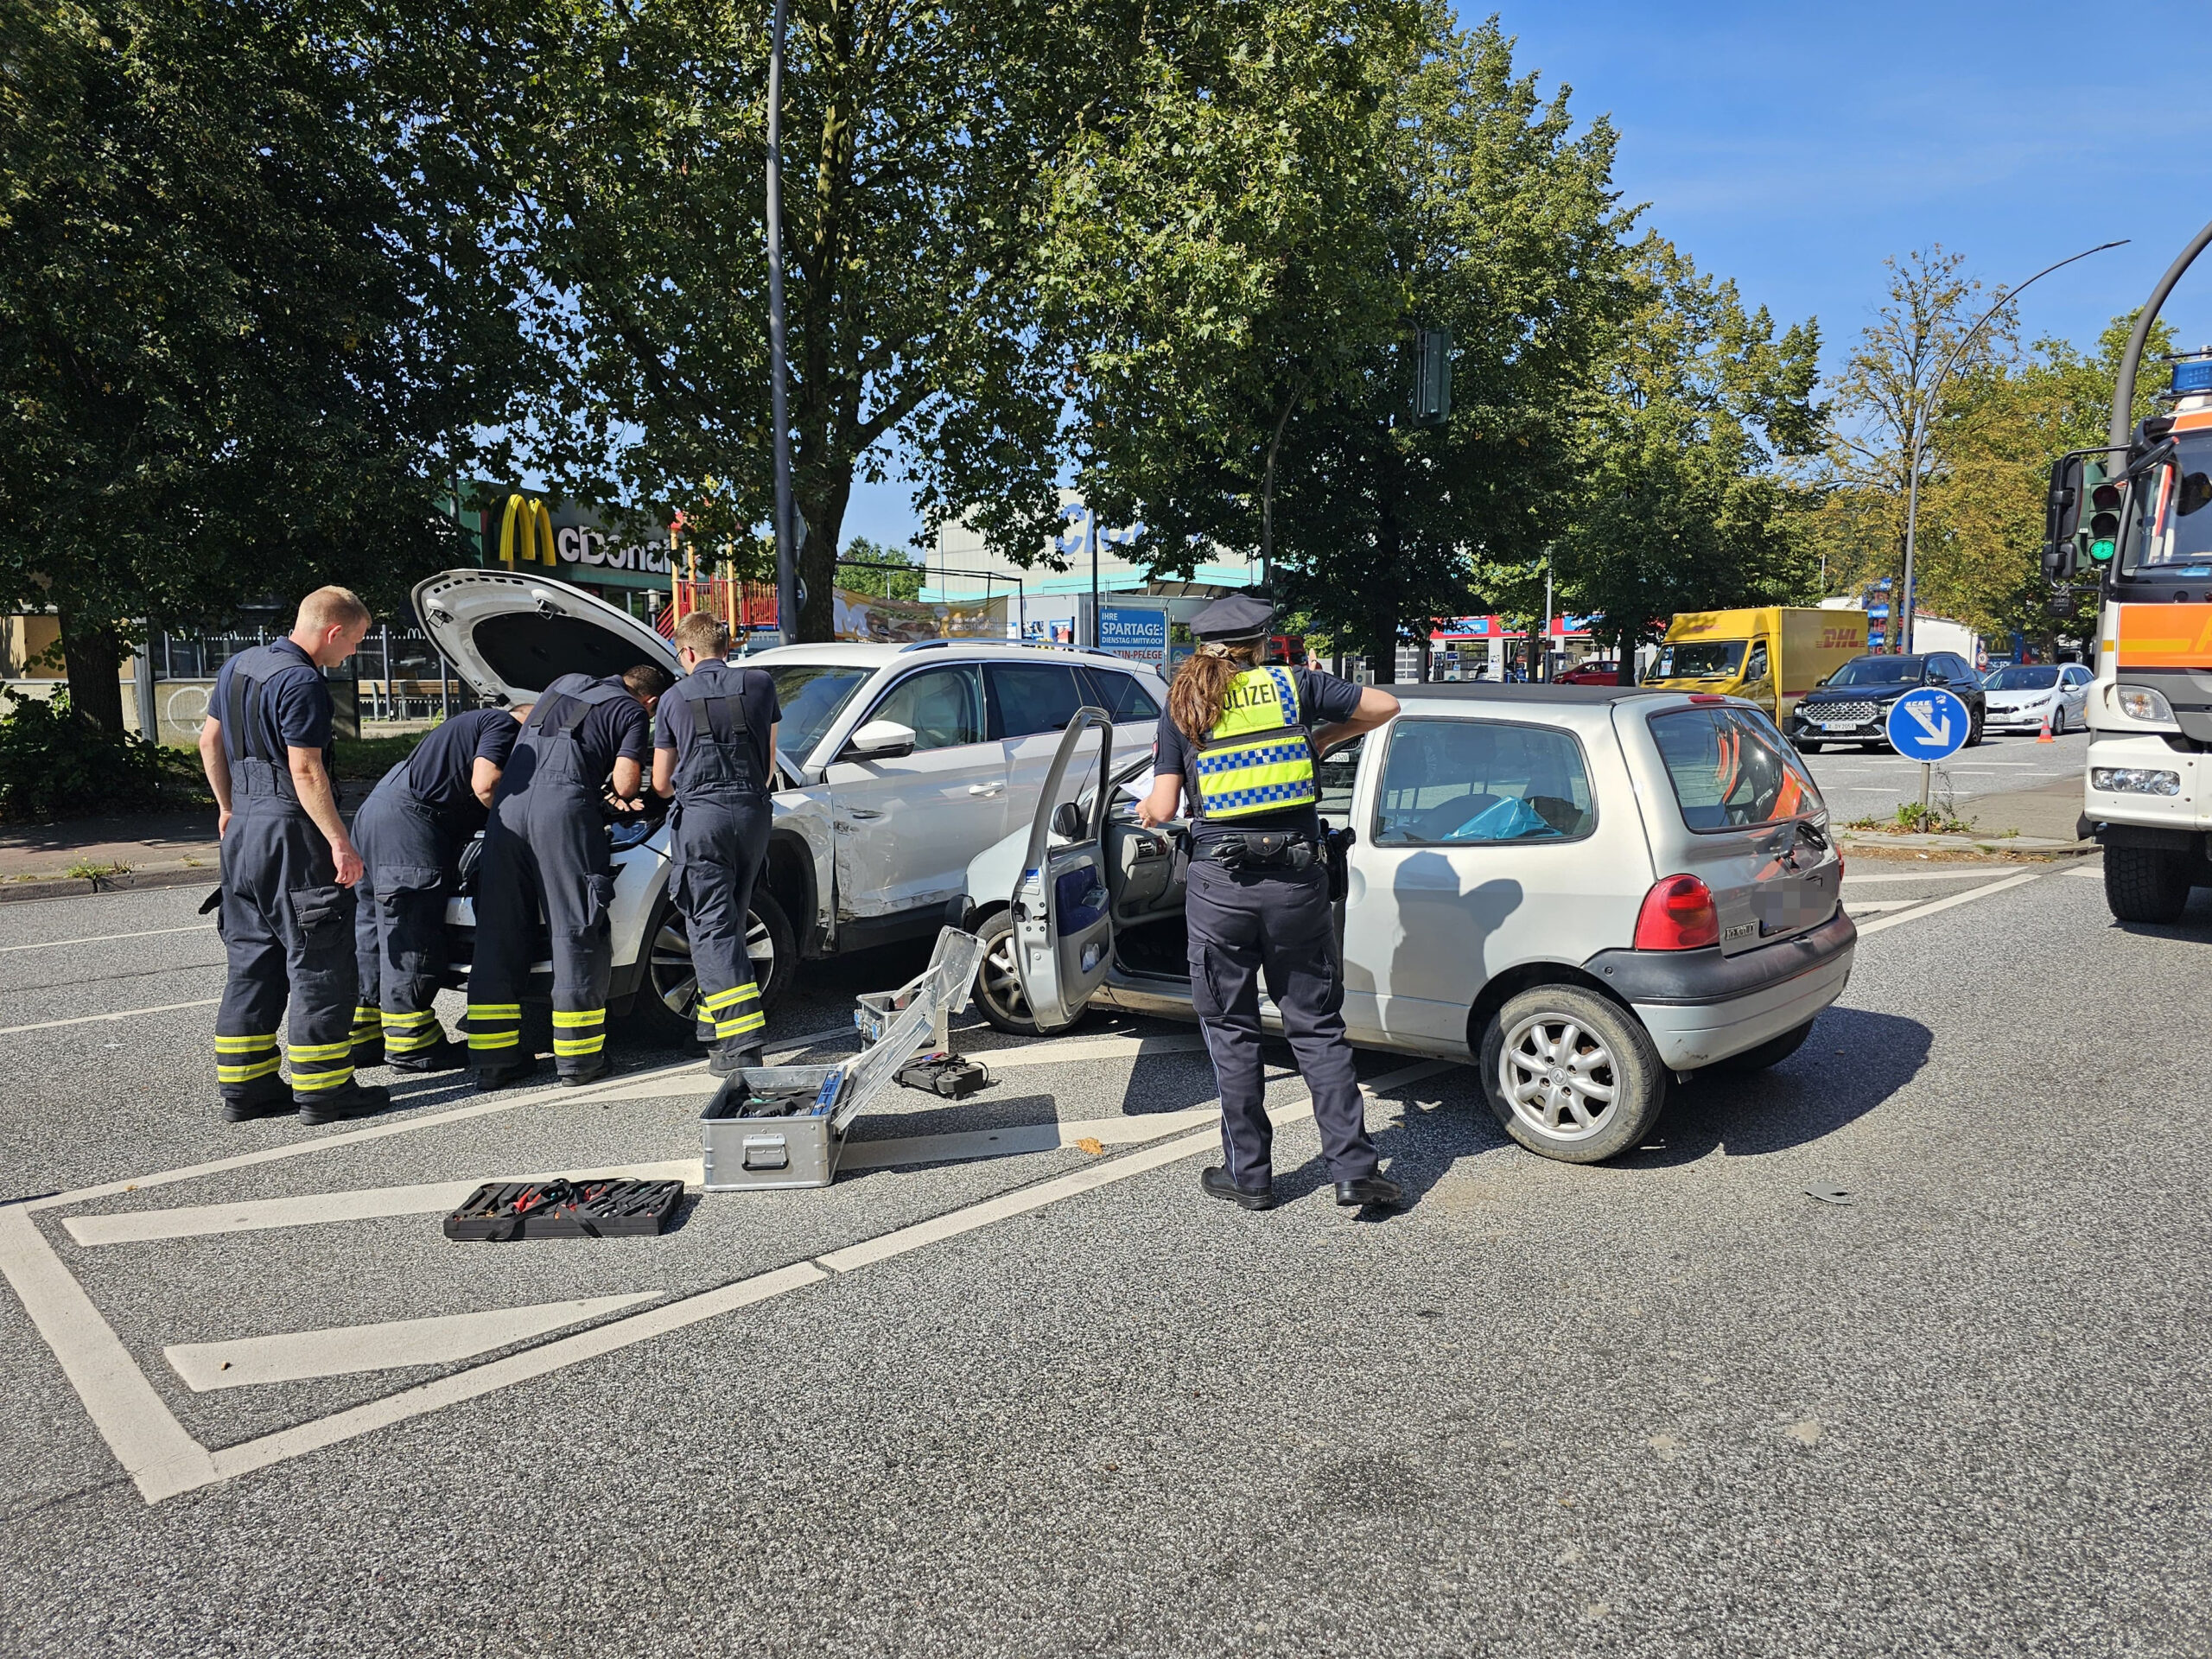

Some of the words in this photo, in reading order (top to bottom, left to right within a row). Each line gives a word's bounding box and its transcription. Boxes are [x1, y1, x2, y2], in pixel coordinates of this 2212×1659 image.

[1102, 622, 1163, 636] SPARTAGE:
[1821, 628, 1859, 648] DHL
[1223, 683, 1277, 710] OLIZEI
